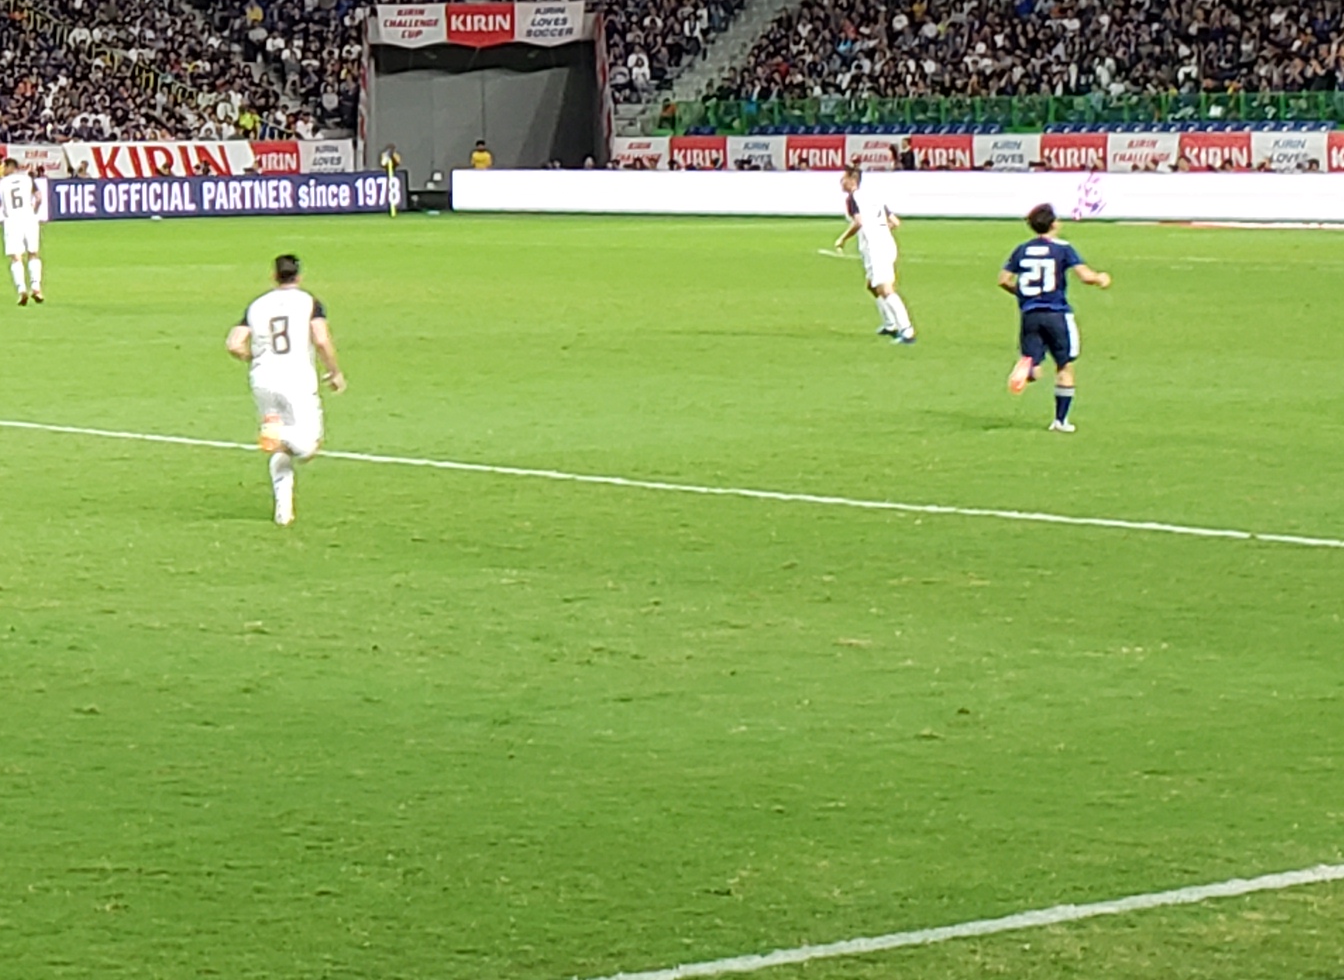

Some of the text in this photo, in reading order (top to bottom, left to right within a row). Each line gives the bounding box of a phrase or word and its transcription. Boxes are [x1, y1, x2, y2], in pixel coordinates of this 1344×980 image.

[450, 13, 510, 32] KIRIN
[531, 17, 568, 27] LOVES
[401, 30, 423, 39] CUP
[526, 27, 573, 38] SOCCER
[1272, 139, 1306, 149] KIRIN
[91, 145, 233, 179] KIRIN
[313, 156, 342, 166] LOVES
[673, 148, 723, 167] KIRIN
[788, 148, 842, 167] KIRIN
[913, 147, 970, 167] KIRIN
[1044, 147, 1103, 168] KIRIN
[11, 188, 24, 209] 6
[55, 176, 401, 214] THE OFFICIAL PARTNER since 1978
[1018, 258, 1056, 296] 21
[269, 315, 291, 355] 8
